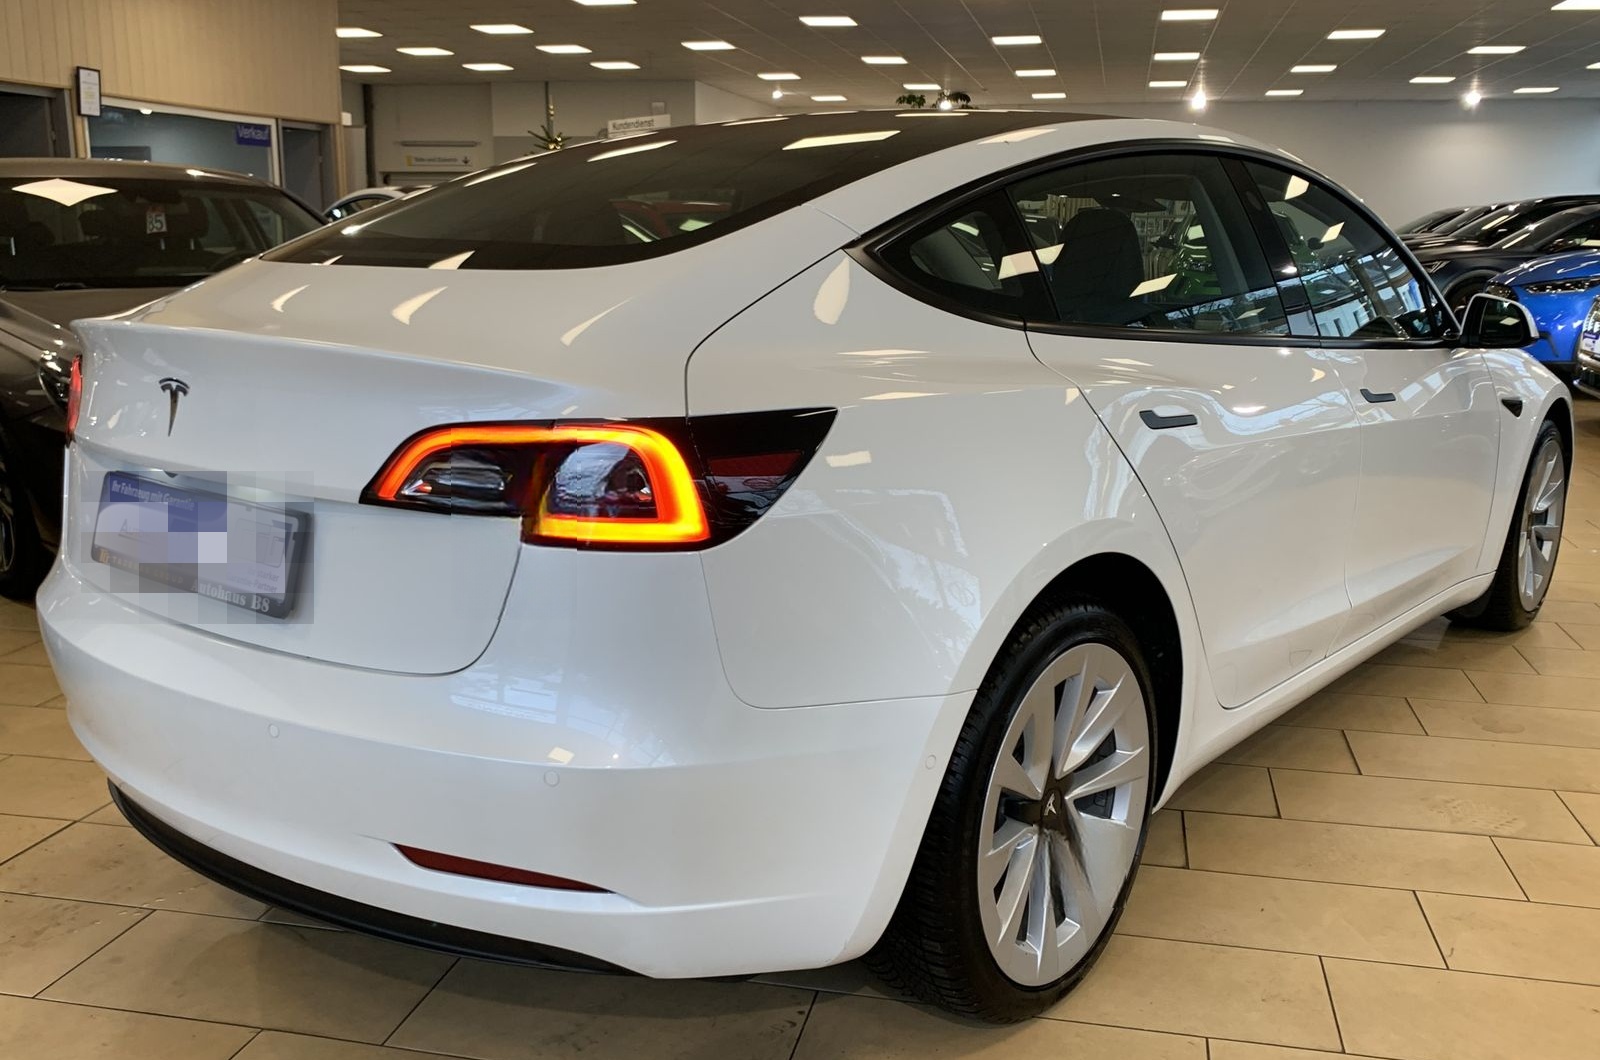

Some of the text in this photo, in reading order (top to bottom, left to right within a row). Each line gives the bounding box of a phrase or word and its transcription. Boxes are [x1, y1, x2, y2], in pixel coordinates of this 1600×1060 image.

[236, 125, 270, 140] Verkauf
[121, 482, 151, 503] Fahrzeug
[150, 491, 163, 503] mit
[190, 579, 270, 612] Autohaus B8
